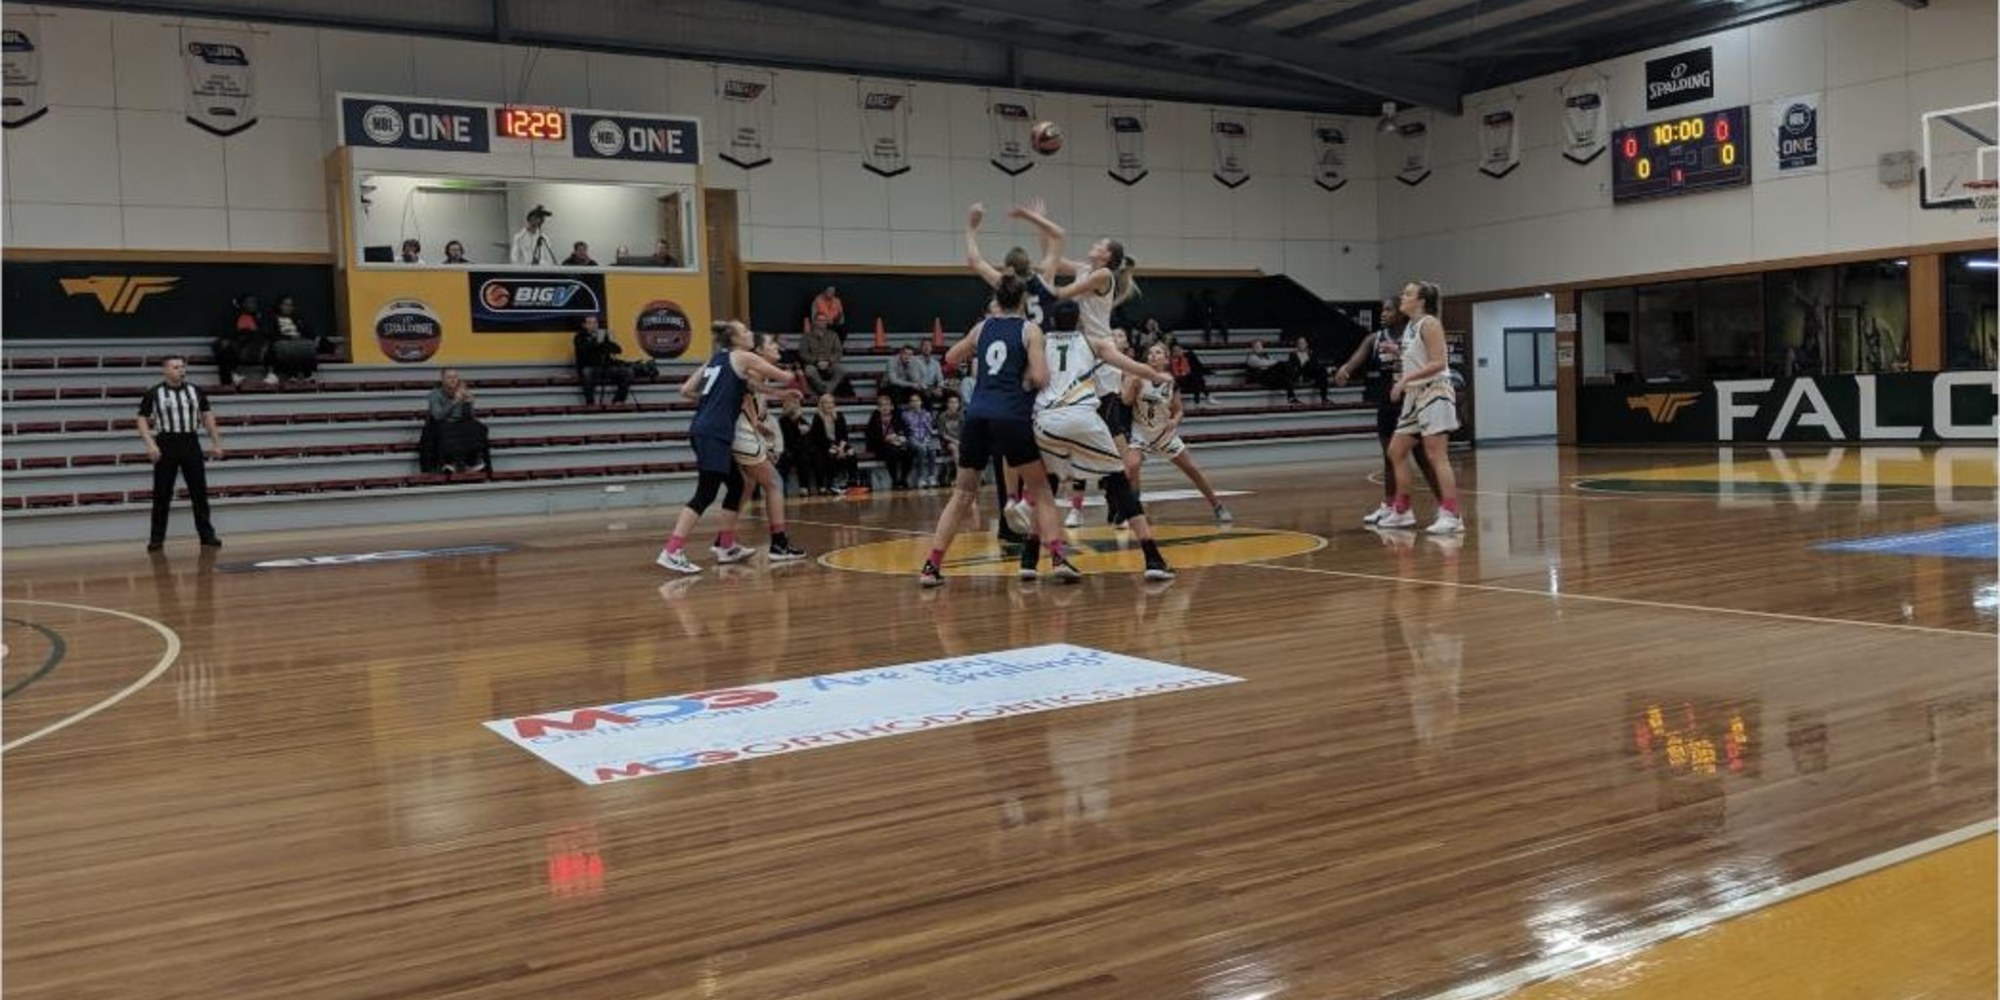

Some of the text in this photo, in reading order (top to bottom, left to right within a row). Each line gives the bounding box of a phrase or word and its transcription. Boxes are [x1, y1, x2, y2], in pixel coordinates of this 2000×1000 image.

[1649, 70, 1710, 100] SPALDING
[408, 112, 471, 142] ONE
[628, 126, 683, 154] ONE
[1654, 118, 1704, 145] 10:00
[1715, 119, 1729, 141] 0
[1624, 138, 1637, 158] 0
[1722, 143, 1734, 165] 0
[1782, 136, 1813, 155] ONE
[1638, 158, 1650, 179] 0
[985, 340, 1007, 375] 9
[702, 365, 721, 395] 7
[1713, 371, 1998, 441] FALC
[811, 670, 906, 691] Are
[513, 688, 779, 739] MOS
[531, 699, 810, 745] ORTHODONTICS
